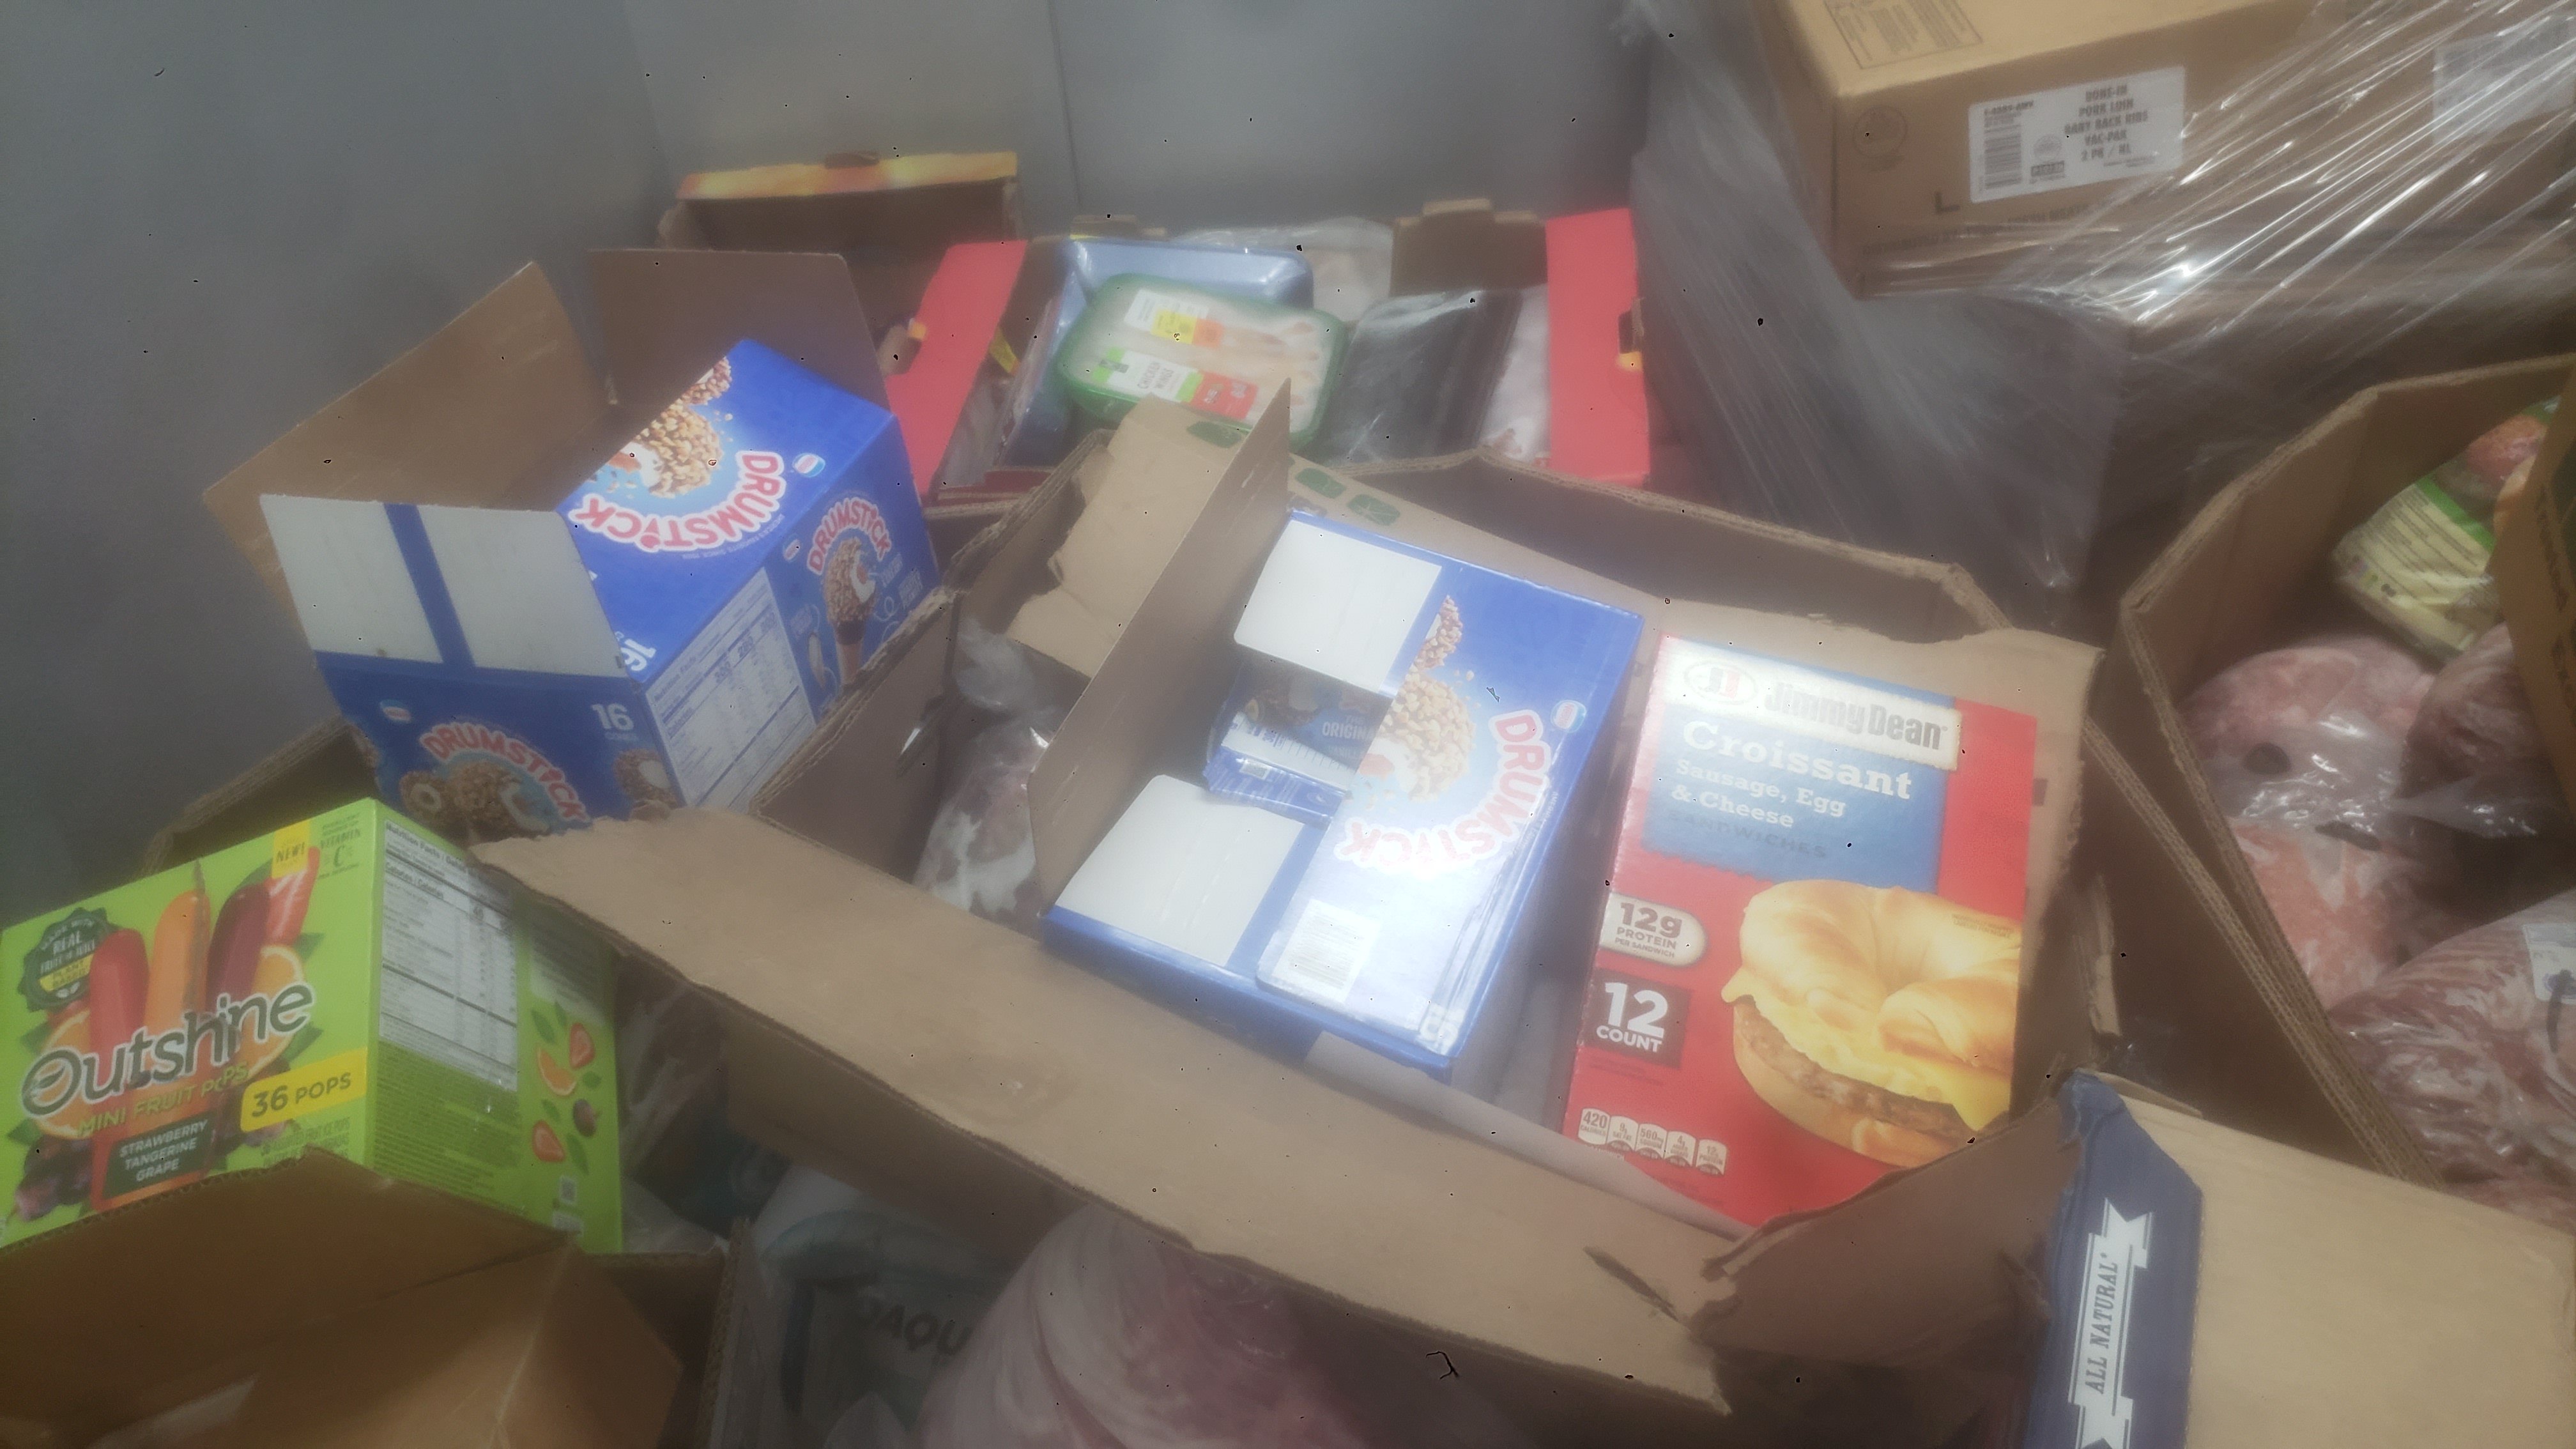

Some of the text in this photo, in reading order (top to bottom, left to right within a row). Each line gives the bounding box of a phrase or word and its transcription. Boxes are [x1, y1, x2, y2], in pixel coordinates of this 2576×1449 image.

[2079, 103, 2106, 117] PORK
[2095, 115, 2122, 130] BACK
[2126, 110, 2148, 125] RIBS
[1137, 360, 1160, 390] CHICKEN
[1154, 368, 1174, 390] WINGS
[573, 452, 783, 551] DRUMSTICK
[808, 499, 891, 573] DRUMSTICK
[591, 703, 634, 731] 16
[1322, 721, 1376, 742] ORIGINA
[1765, 681, 1942, 751] Jimmy Dean
[421, 723, 588, 820] DRUMSTICK
[1683, 719, 1913, 801] Croissant
[1338, 711, 1549, 867] DRUMSTICK
[1671, 785, 1795, 829] & Cheese
[1675, 759, 1846, 818] Sausage, Egg
[275, 841, 306, 865] NEW!
[1667, 809, 1827, 859] SANDWICHES
[1616, 926, 1677, 951] PROTEIN
[1620, 902, 1683, 939] 12g
[52, 930, 80, 954] REAL
[1614, 937, 1676, 958] PER SANDWICH
[1604, 982, 1669, 1039] 12
[22, 984, 314, 1116] Outshine
[1597, 1025, 1662, 1053] COUNT
[77, 1108, 126, 1137] MINI
[132, 1085, 193, 1118] FRUIT
[252, 1072, 351, 1118] 36 POPS
[119, 1119, 209, 1158] STRAWBERRY
[1583, 1111, 1608, 1129] 420
[125, 1137, 197, 1170] TANGERINE
[135, 1158, 180, 1182] GRAPE
[2084, 1252, 2119, 1395] ALL NATURAL
